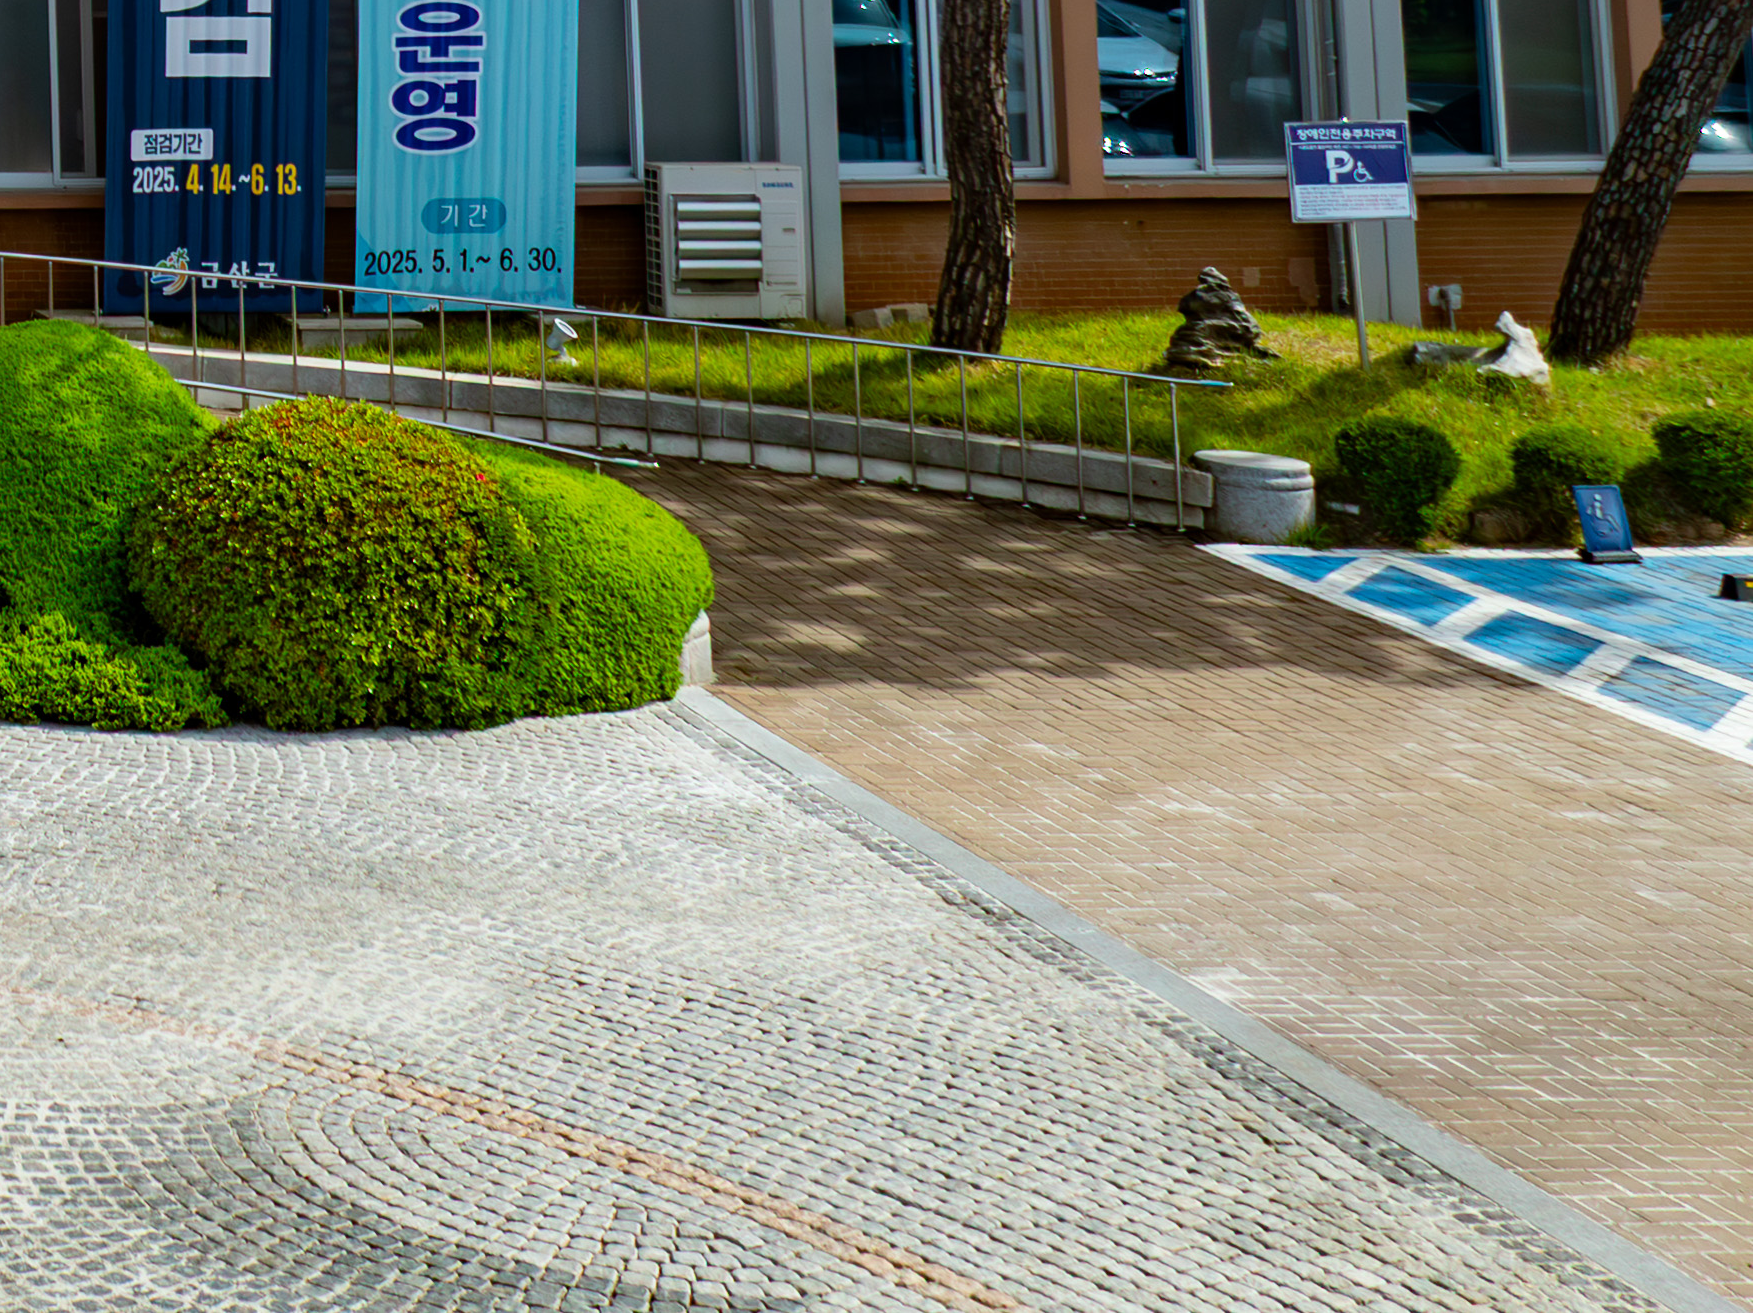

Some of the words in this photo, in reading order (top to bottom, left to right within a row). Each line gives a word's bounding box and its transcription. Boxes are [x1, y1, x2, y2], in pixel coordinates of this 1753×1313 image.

[143, 133, 203, 156] 점검기간
[133, 166, 180, 194] 2025.
[186, 164, 204, 194] 4.
[276, 164, 302, 195] 13.
[364, 252, 423, 276] 2025.
[433, 250, 455, 274] 5.
[500, 248, 518, 272] 6.
[528, 247, 562, 272] 30.
